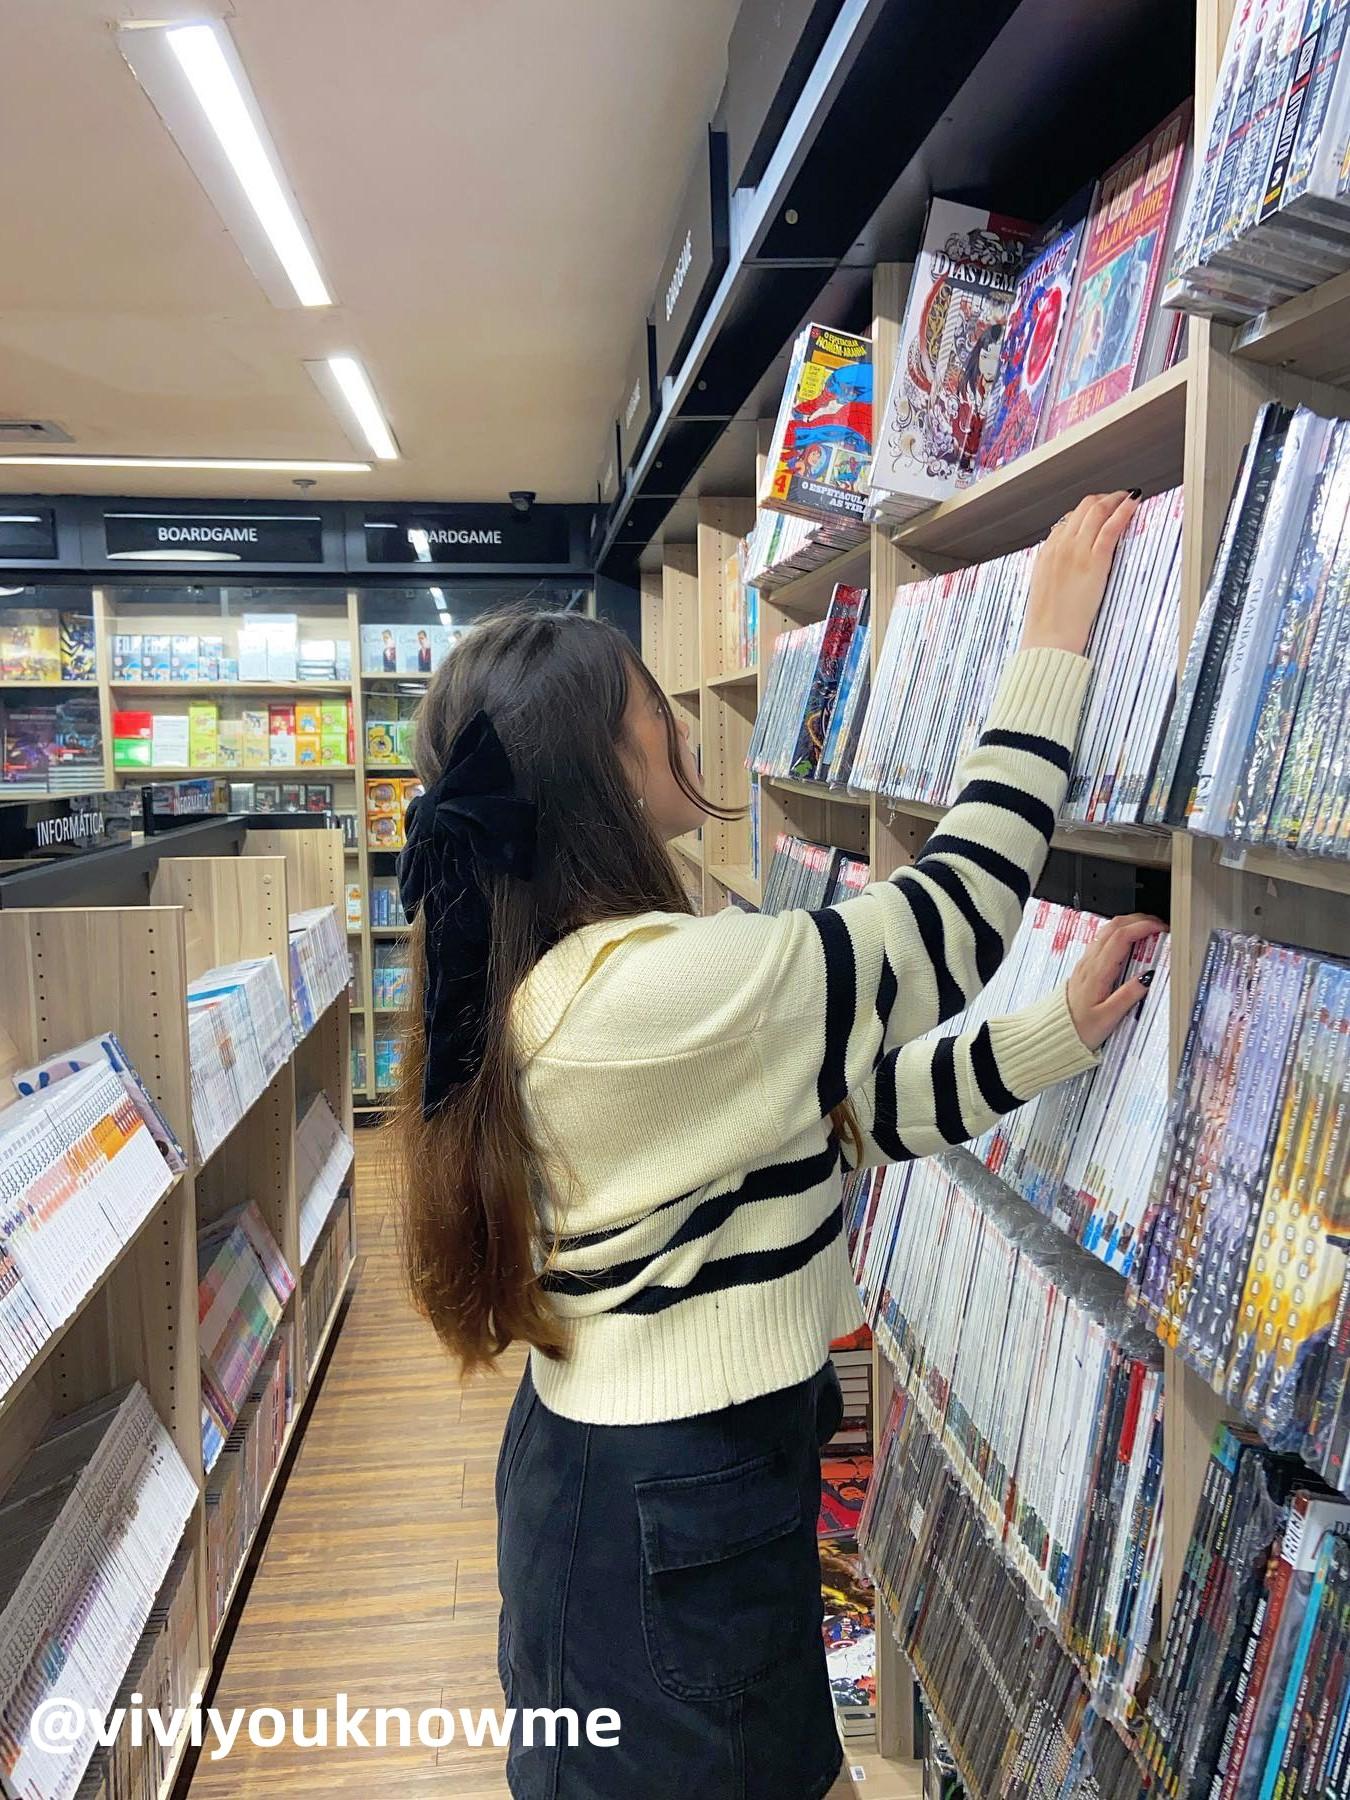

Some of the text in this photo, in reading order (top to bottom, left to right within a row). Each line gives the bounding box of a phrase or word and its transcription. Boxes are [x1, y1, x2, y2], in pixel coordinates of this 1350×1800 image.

[1271, 169, 1281, 188] 3
[1097, 217, 1126, 256] ALAN
[1125, 184, 1167, 234] MOORE
[933, 251, 977, 282] DIAS
[1018, 239, 1073, 294] THANOS
[774, 475, 786, 493] 4
[801, 482, 809, 490] O
[829, 498, 845, 508] AS
[158, 527, 258, 542] BOARDGAME
[37, 808, 104, 847] INFORMÁTICA
[1193, 942, 1217, 1021] BILL WILLINGHAM
[1286, 974, 1312, 1065] BILL WILLINGHAM
[1302, 976, 1329, 1070] BILL WILLINGHAM
[1322, 1060, 1331, 1082] BILL
[1314, 1093, 1324, 1116] LUXO
[1335, 1103, 1345, 1126] LUXO
[1148, 1257, 1157, 1280] 3
[1157, 1266, 1166, 1291] 3
[1178, 1282, 1189, 1304] 6
[1210, 1307, 1222, 1334] 7
[1223, 1320, 1233, 1345] 8
[1236, 1331, 1247, 1357] 9
[1254, 1351, 1266, 1376] 9
[1272, 1366, 1285, 1392] 9
[1278, 1508, 1308, 1565] VERTIGO
[1241, 1636, 1258, 1671] BATISTA
[1233, 1671, 1250, 1703] LEVITZ
